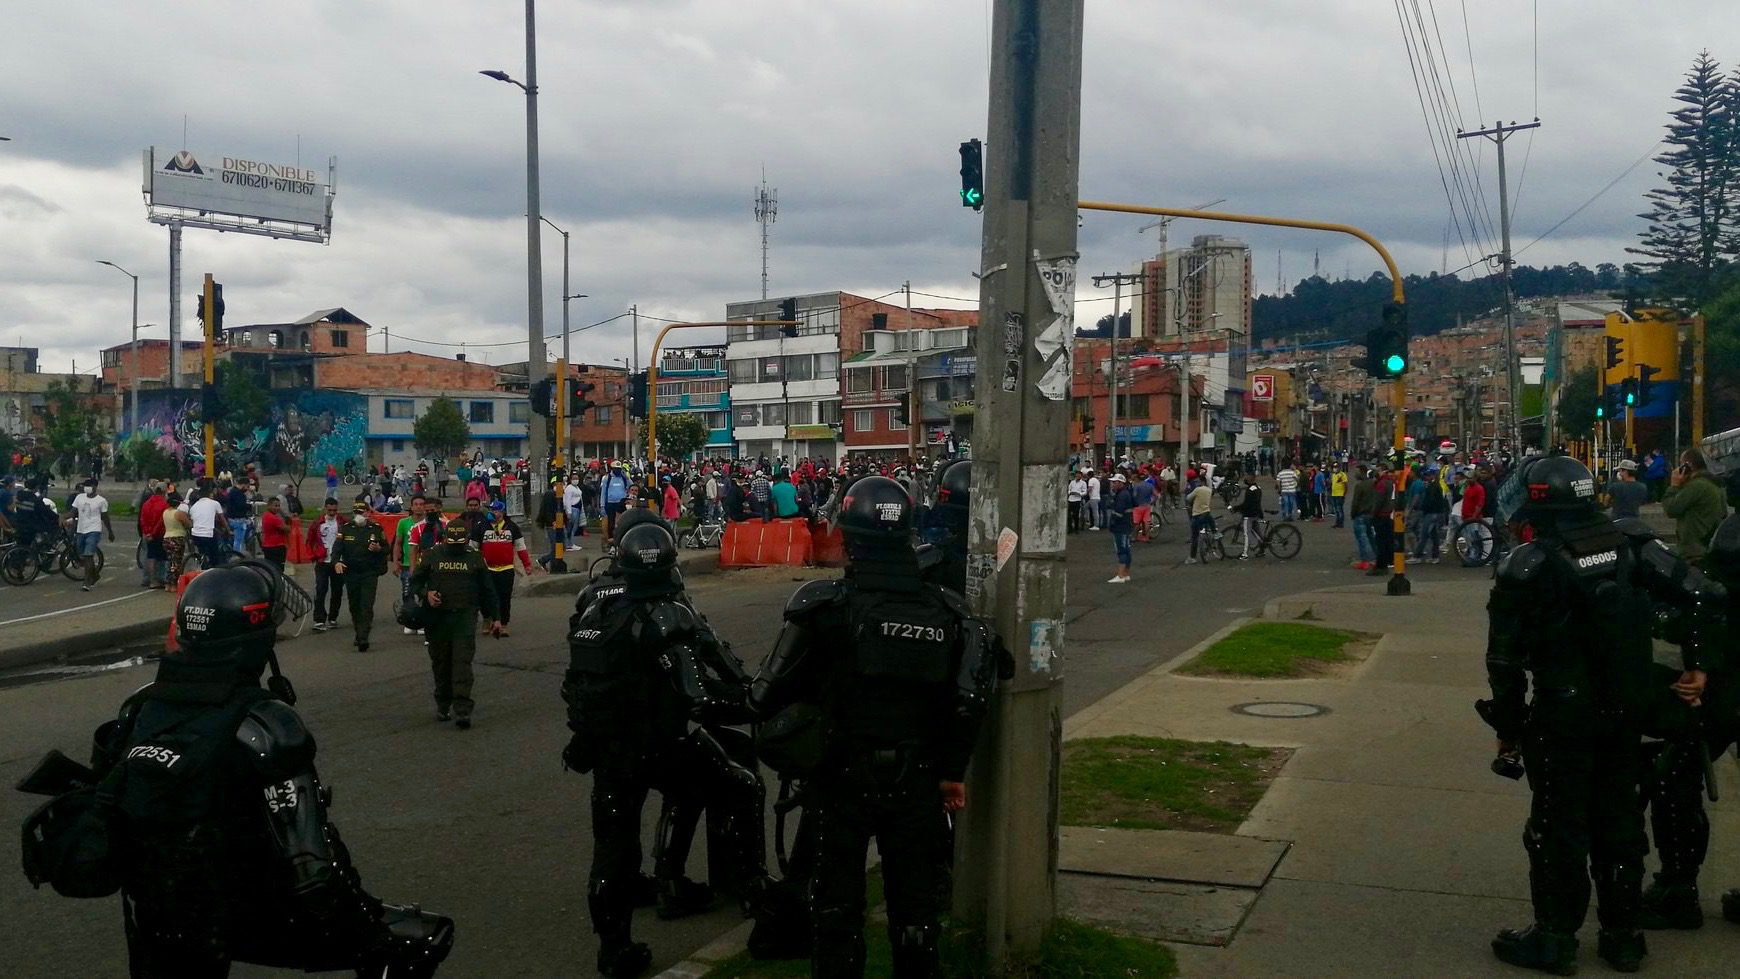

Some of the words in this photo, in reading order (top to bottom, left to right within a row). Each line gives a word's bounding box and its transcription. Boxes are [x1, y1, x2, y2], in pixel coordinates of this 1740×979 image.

[222, 156, 316, 182] DISPONIBLE
[439, 561, 468, 571] POLICIA
[1578, 550, 1618, 568] 086005
[881, 621, 945, 643] 172730
[127, 745, 181, 769] 172551
[264, 779, 296, 801] M-3
[268, 793, 298, 814] S-3
